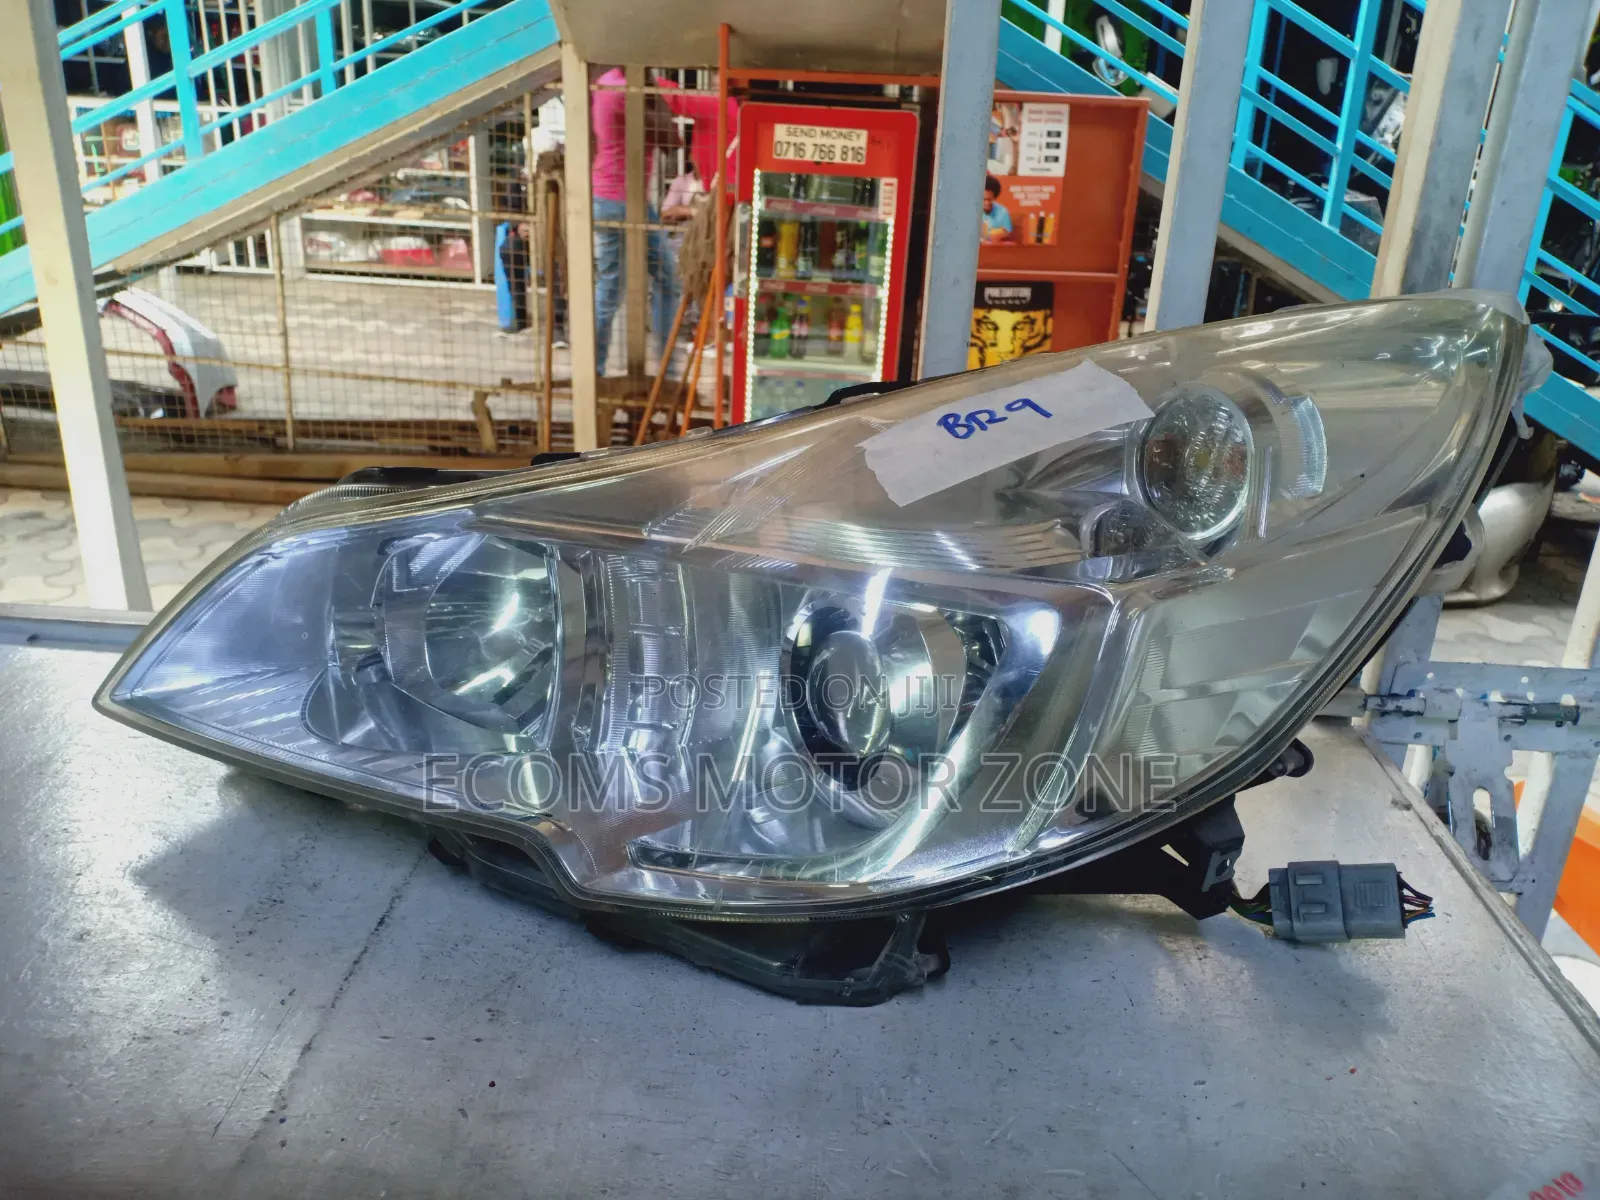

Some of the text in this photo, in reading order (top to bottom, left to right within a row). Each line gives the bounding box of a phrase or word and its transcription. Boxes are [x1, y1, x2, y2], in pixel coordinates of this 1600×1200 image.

[785, 126, 863, 141] SEND MONEY
[774, 140, 865, 163] 0716 766 816
